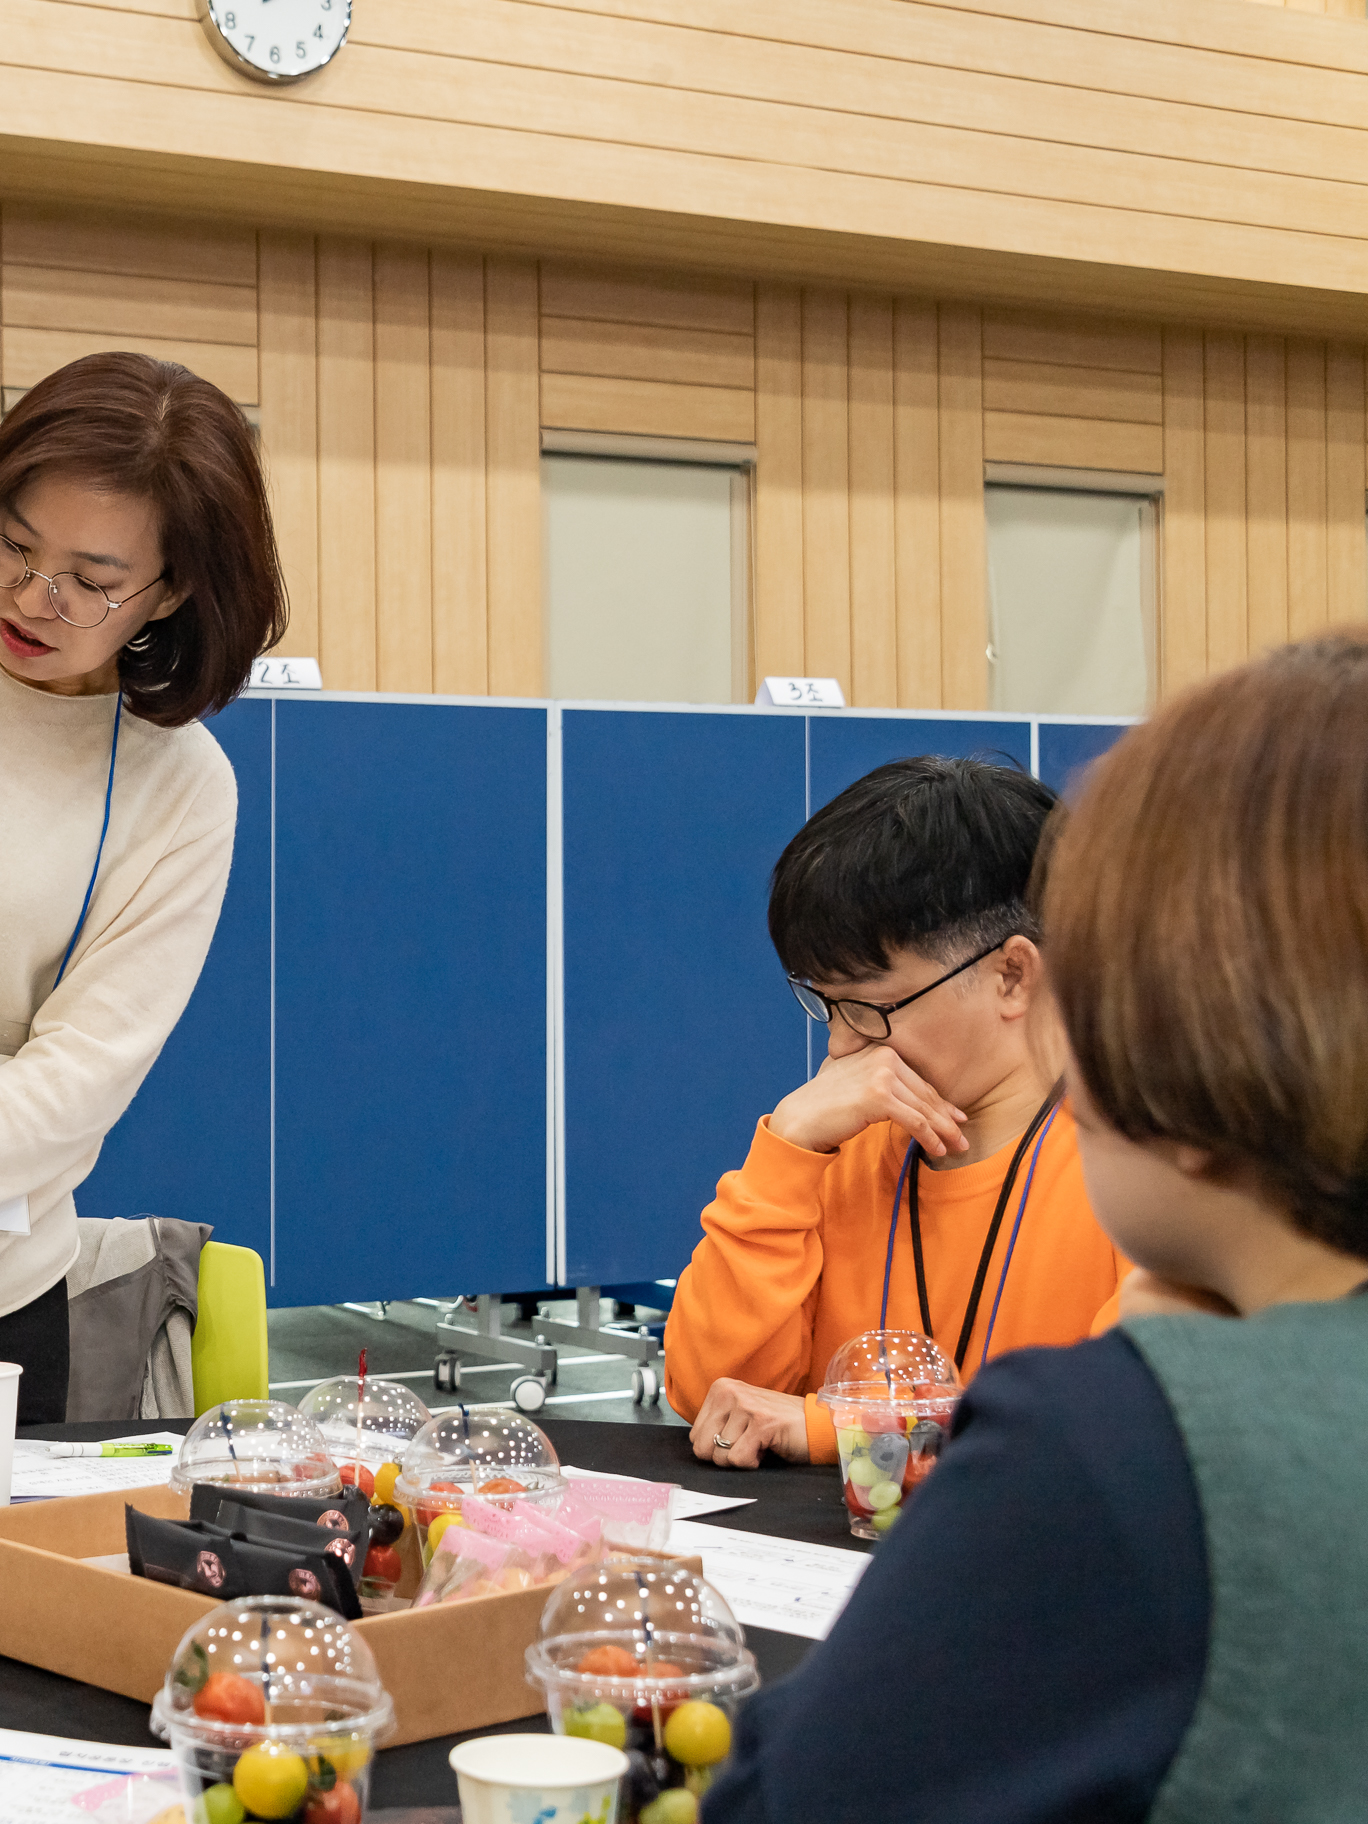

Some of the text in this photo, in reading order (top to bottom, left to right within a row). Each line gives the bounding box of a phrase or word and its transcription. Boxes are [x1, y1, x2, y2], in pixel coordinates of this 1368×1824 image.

[224, 11, 236, 30] 8
[312, 24, 324, 41] 4
[244, 35, 255, 52] 7
[295, 41, 307, 59] 5
[269, 46, 281, 64] 6
